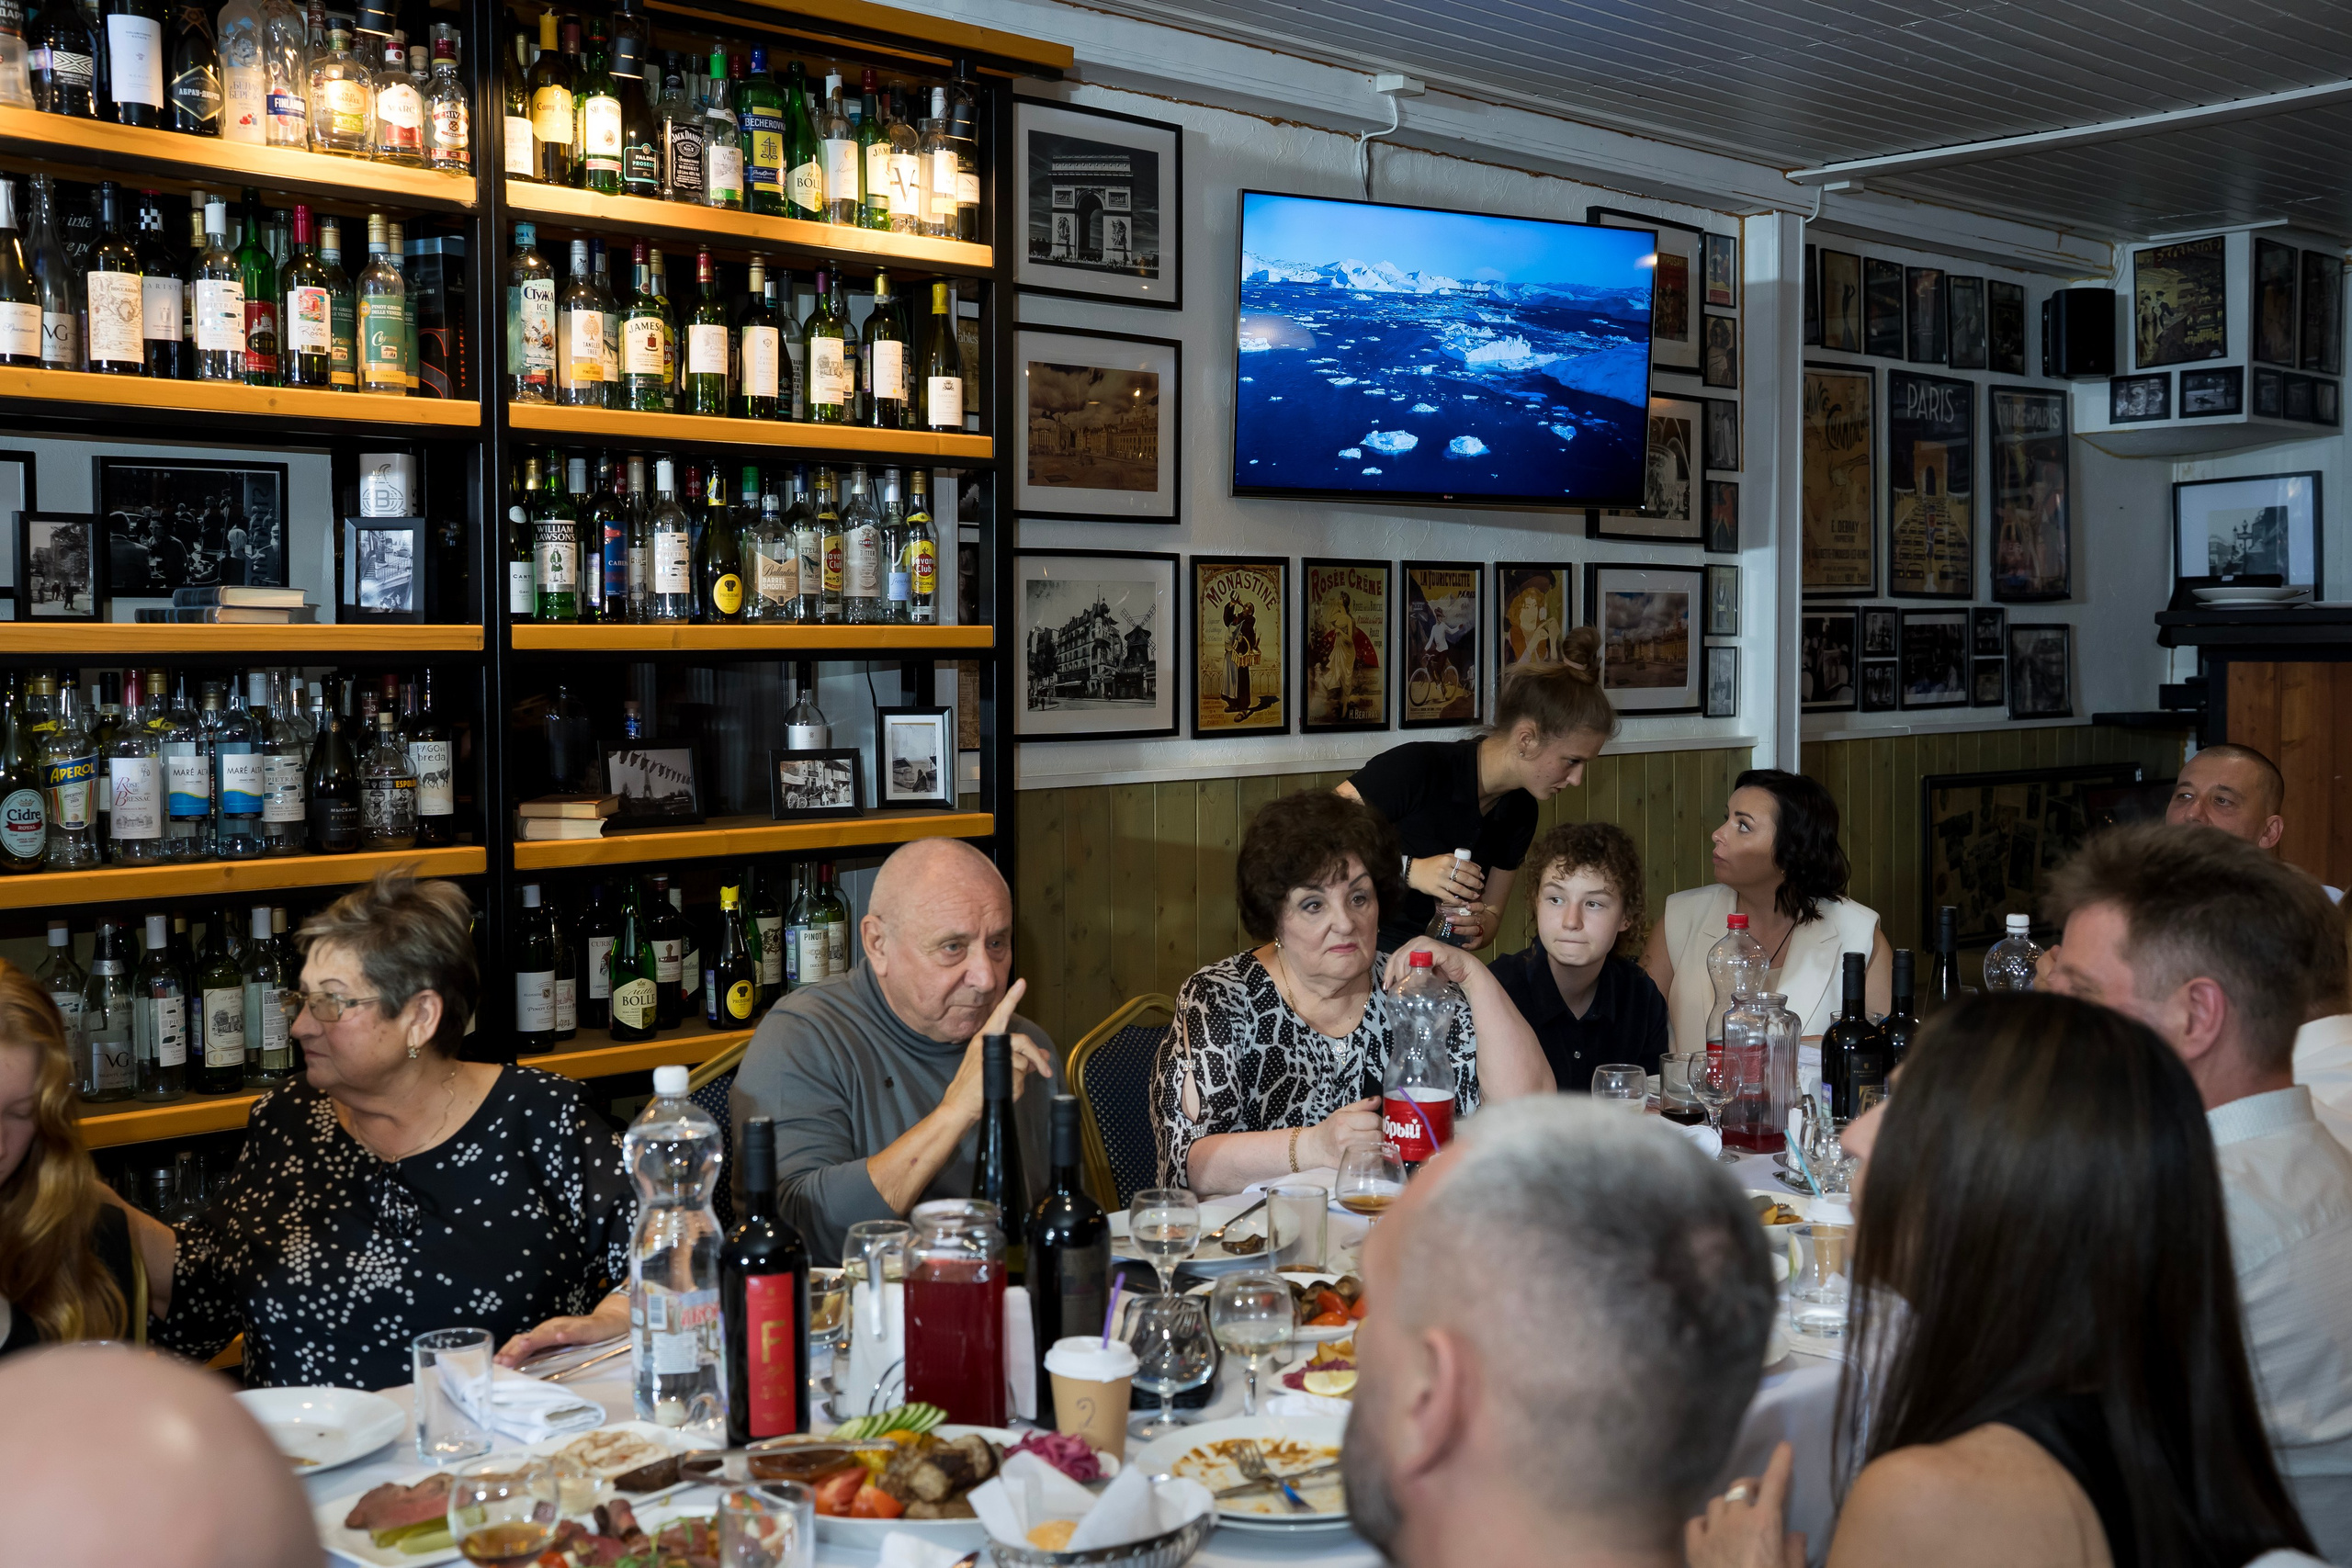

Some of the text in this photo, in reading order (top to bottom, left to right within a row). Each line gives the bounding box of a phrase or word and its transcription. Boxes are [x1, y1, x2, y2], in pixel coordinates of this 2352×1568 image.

[56, 71, 83, 80] PROSECCO
[744, 118, 786, 130] BECHEROVKA
[672, 131, 685, 143] JACK
[797, 177, 820, 189] BOLL
[536, 303, 548, 312] ICE
[628, 321, 663, 333] JAMESO
[958, 332, 978, 345] ables
[1906, 382, 1955, 423] PARIS
[2030, 406, 2061, 429] PARIS
[537, 525, 573, 533] WILLIAM
[1838, 520, 1860, 534] DEBRAY
[535, 533, 576, 542] LAWSON'S
[916, 564, 932, 573] Club
[1310, 567, 1383, 603] ROSÉE CRÊME
[1419, 570, 1471, 590] LA TOURICYCLETTE
[1205, 570, 1278, 612] MONASTINE
[1457, 590, 1476, 599] PARIS
[417, 753, 447, 761] breda
[50, 762, 96, 784] APEROL
[173, 767, 195, 776] MARÉ
[227, 766, 263, 774] MARÉ ALTA
[115, 790, 151, 807] BRESSAC
[6, 808, 41, 821] Cidre
[804, 932, 823, 941] PINOT
[105, 1051, 130, 1068] VG
[1384, 1114, 1420, 1140] брый
[761, 1320, 786, 1364] F
